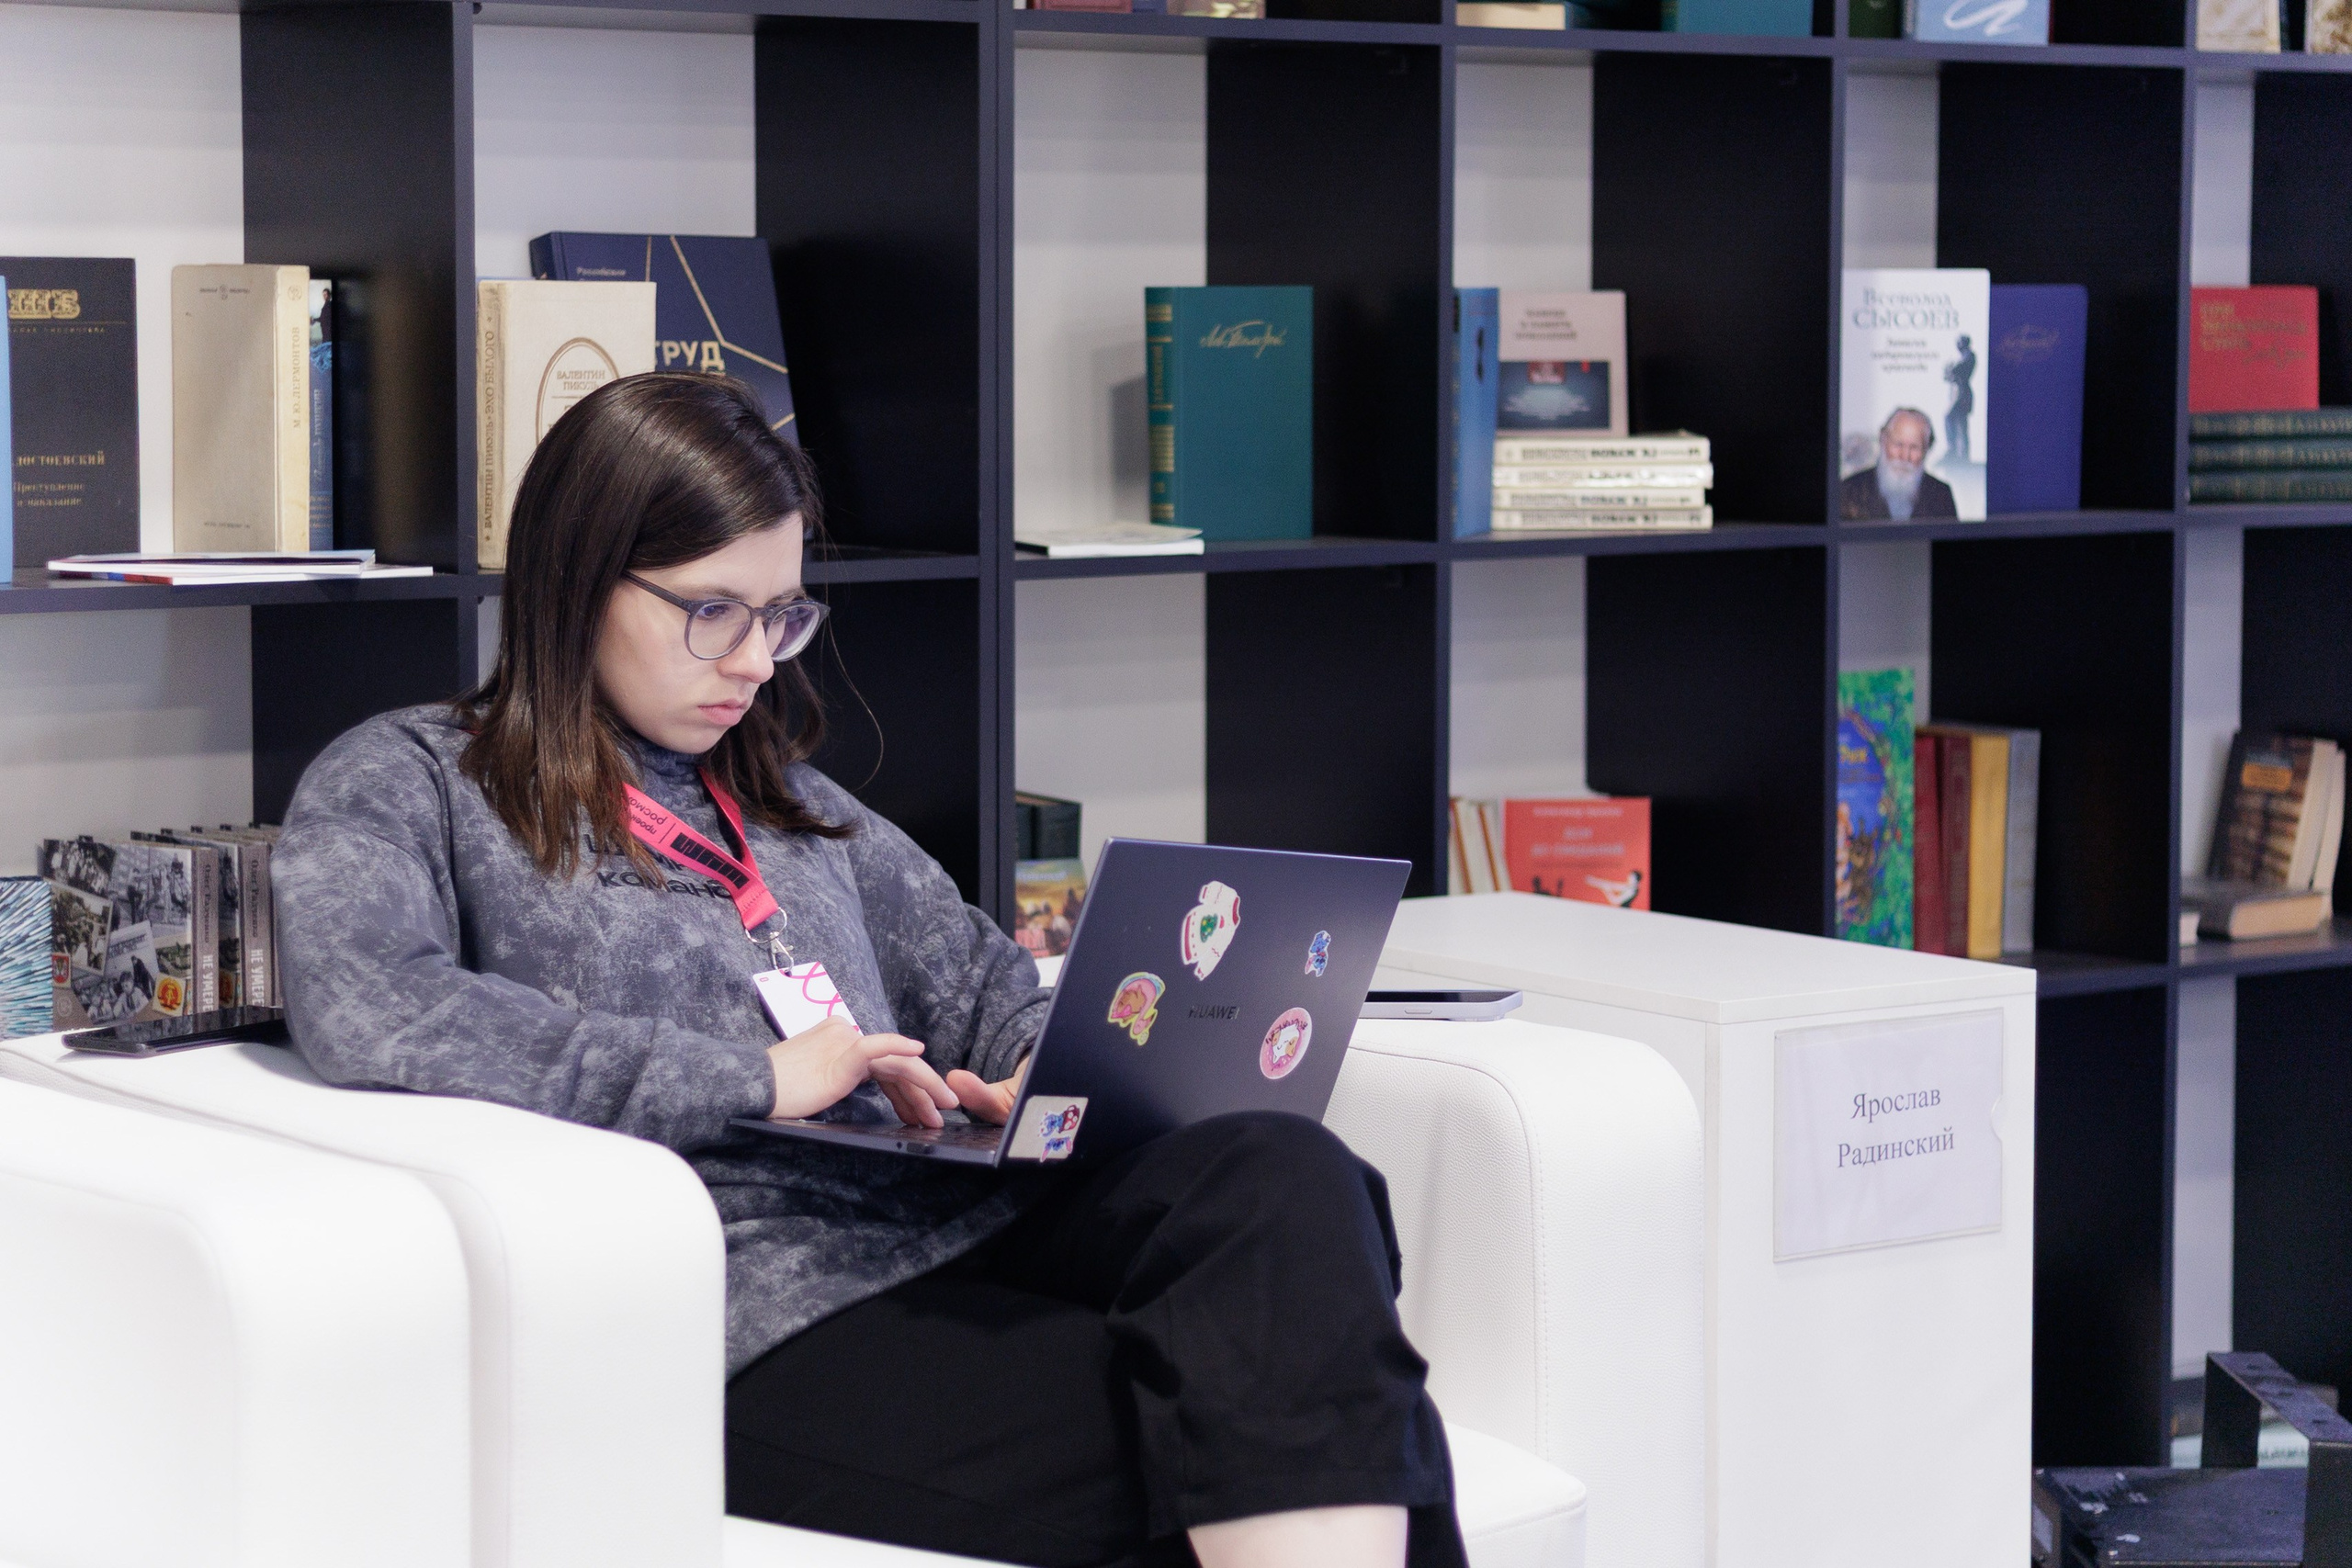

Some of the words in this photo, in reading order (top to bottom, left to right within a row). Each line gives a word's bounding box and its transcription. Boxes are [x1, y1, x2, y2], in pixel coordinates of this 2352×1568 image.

[1851, 309, 1961, 331] СЫСОЕВ
[291, 326, 301, 400] ЛЕРМОНТОВ
[484, 331, 494, 384] БЫЛОГО
[655, 340, 726, 376] РУД
[556, 369, 605, 381] ВАЛЕНТИН
[563, 381, 600, 391] ПИКУЛЬ
[484, 387, 494, 414] ЭХО
[484, 421, 494, 467] ПИКУЛЬ
[485, 468, 493, 529] ВАЛЕНТИН
[628, 796, 668, 825] росмо
[630, 815, 658, 835] проек
[202, 954, 214, 969] НЕ
[250, 949, 264, 964] НЕ
[202, 972, 214, 1011] УМЕРЕ
[251, 966, 265, 1007] УМЕРЕ
[1188, 1005, 1240, 1020] HUAWEI
[1849, 1089, 1942, 1123] Ярослав
[1837, 1126, 1955, 1168] Радинский
